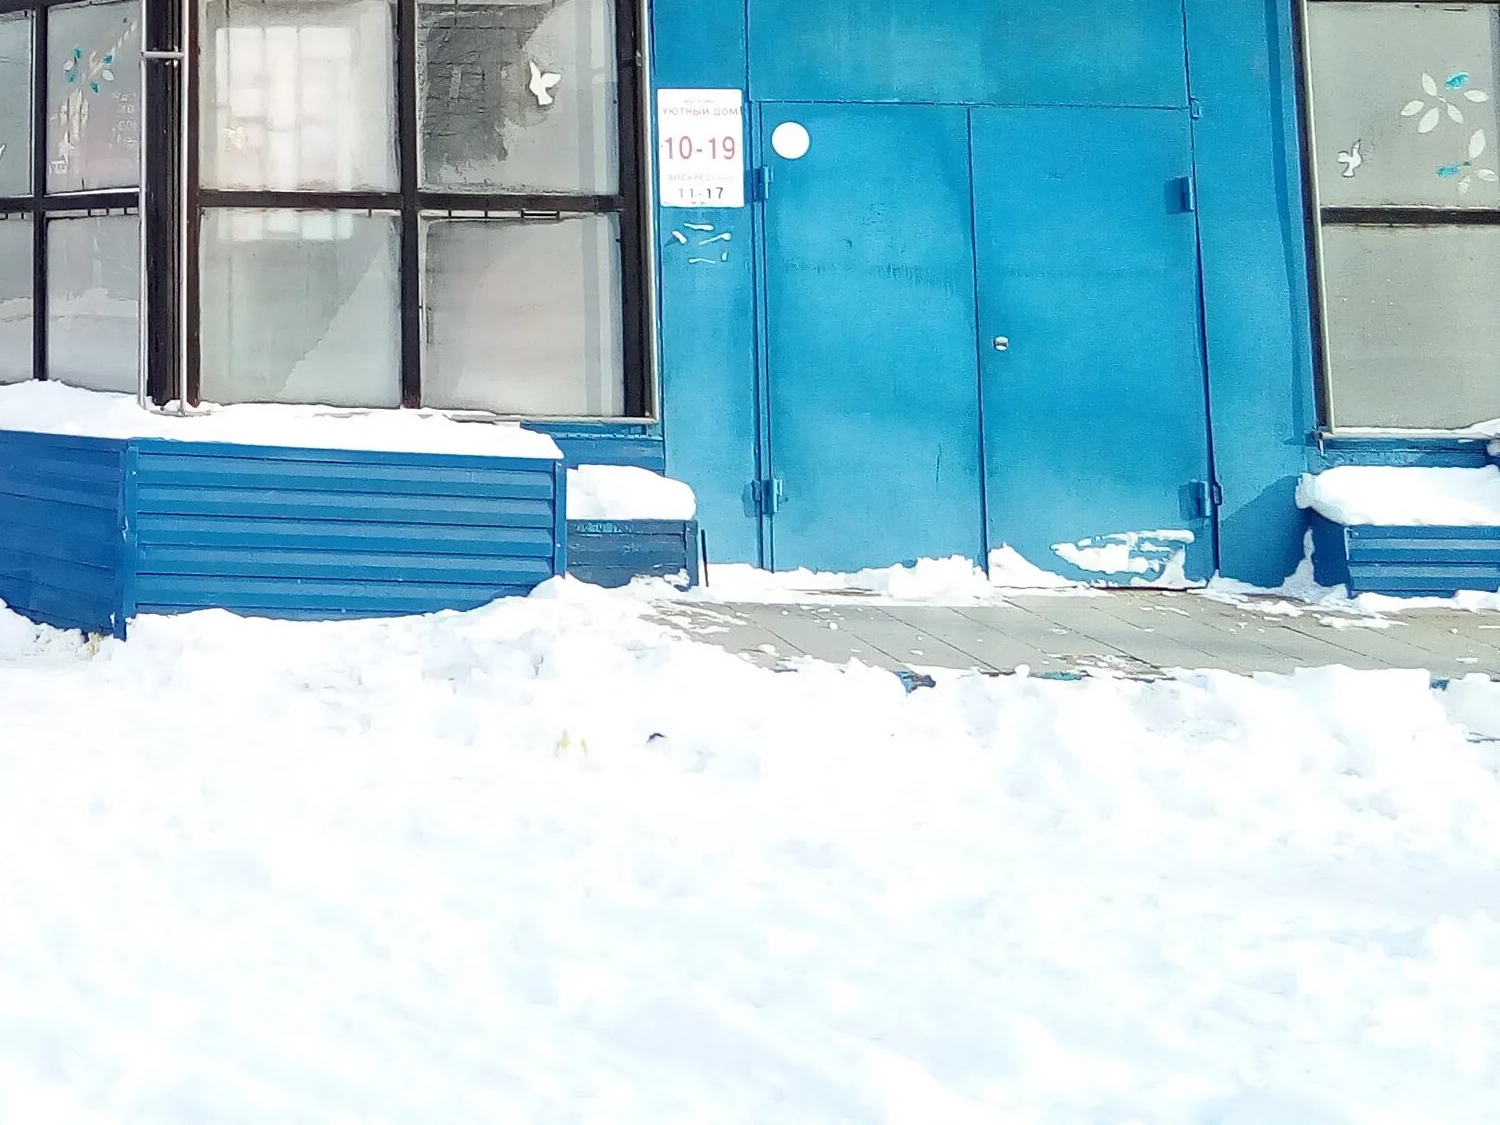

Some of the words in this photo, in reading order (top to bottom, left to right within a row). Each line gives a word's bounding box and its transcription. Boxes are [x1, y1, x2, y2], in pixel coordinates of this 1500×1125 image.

[713, 107, 738, 116] ДОМ
[665, 136, 735, 160] 10-19
[679, 187, 724, 199] 11-17
